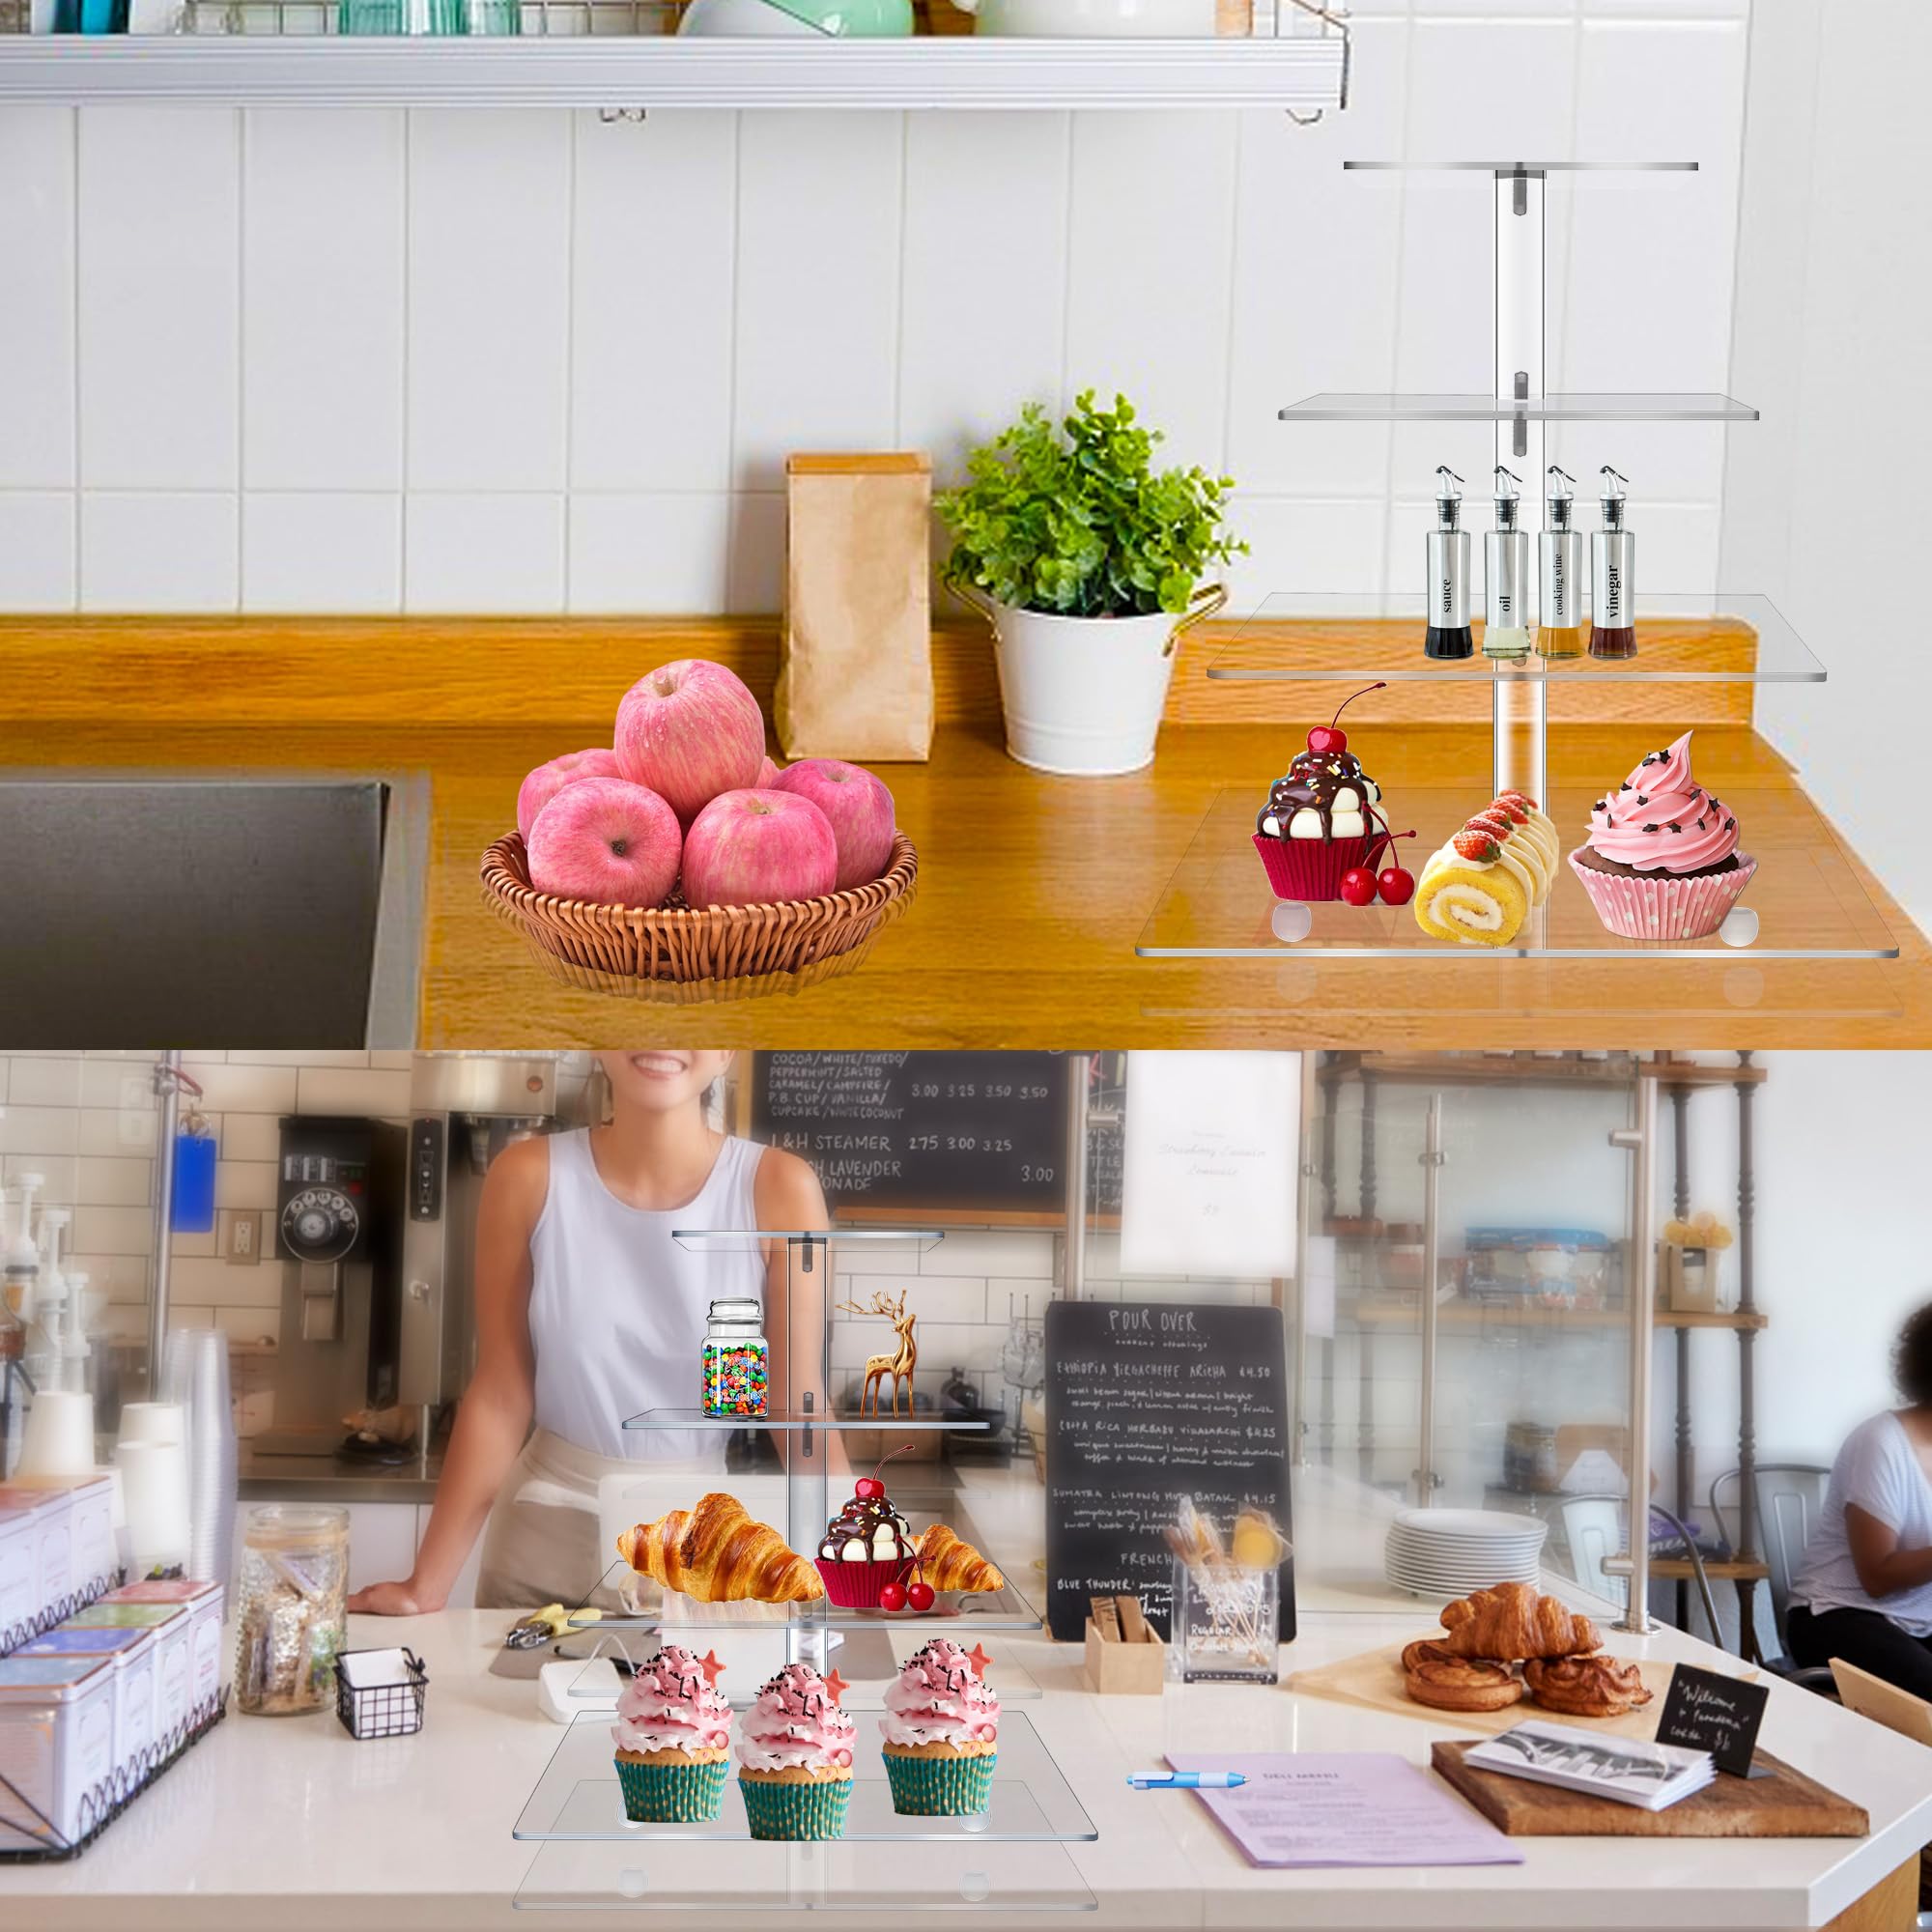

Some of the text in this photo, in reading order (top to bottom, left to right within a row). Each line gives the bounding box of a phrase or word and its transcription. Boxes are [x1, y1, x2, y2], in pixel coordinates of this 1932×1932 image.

[1552, 554, 1564, 615] cooking wine
[1605, 565, 1621, 618] vinegar
[1442, 579, 1452, 612] sauce
[1499, 596, 1510, 611] oil
[815, 1135, 892, 1151] STEAMER
[830, 1159, 901, 1178] LAVENDER
[1021, 1165, 1054, 1182] 3.00
[821, 1177, 872, 1191] ONADE
[1109, 1309, 1197, 1331] POUR OVER
[1053, 1488, 1102, 1498] SUMATRA
[1121, 1552, 1173, 1566] FRENCH
[1057, 1577, 1081, 1590] BLUE
